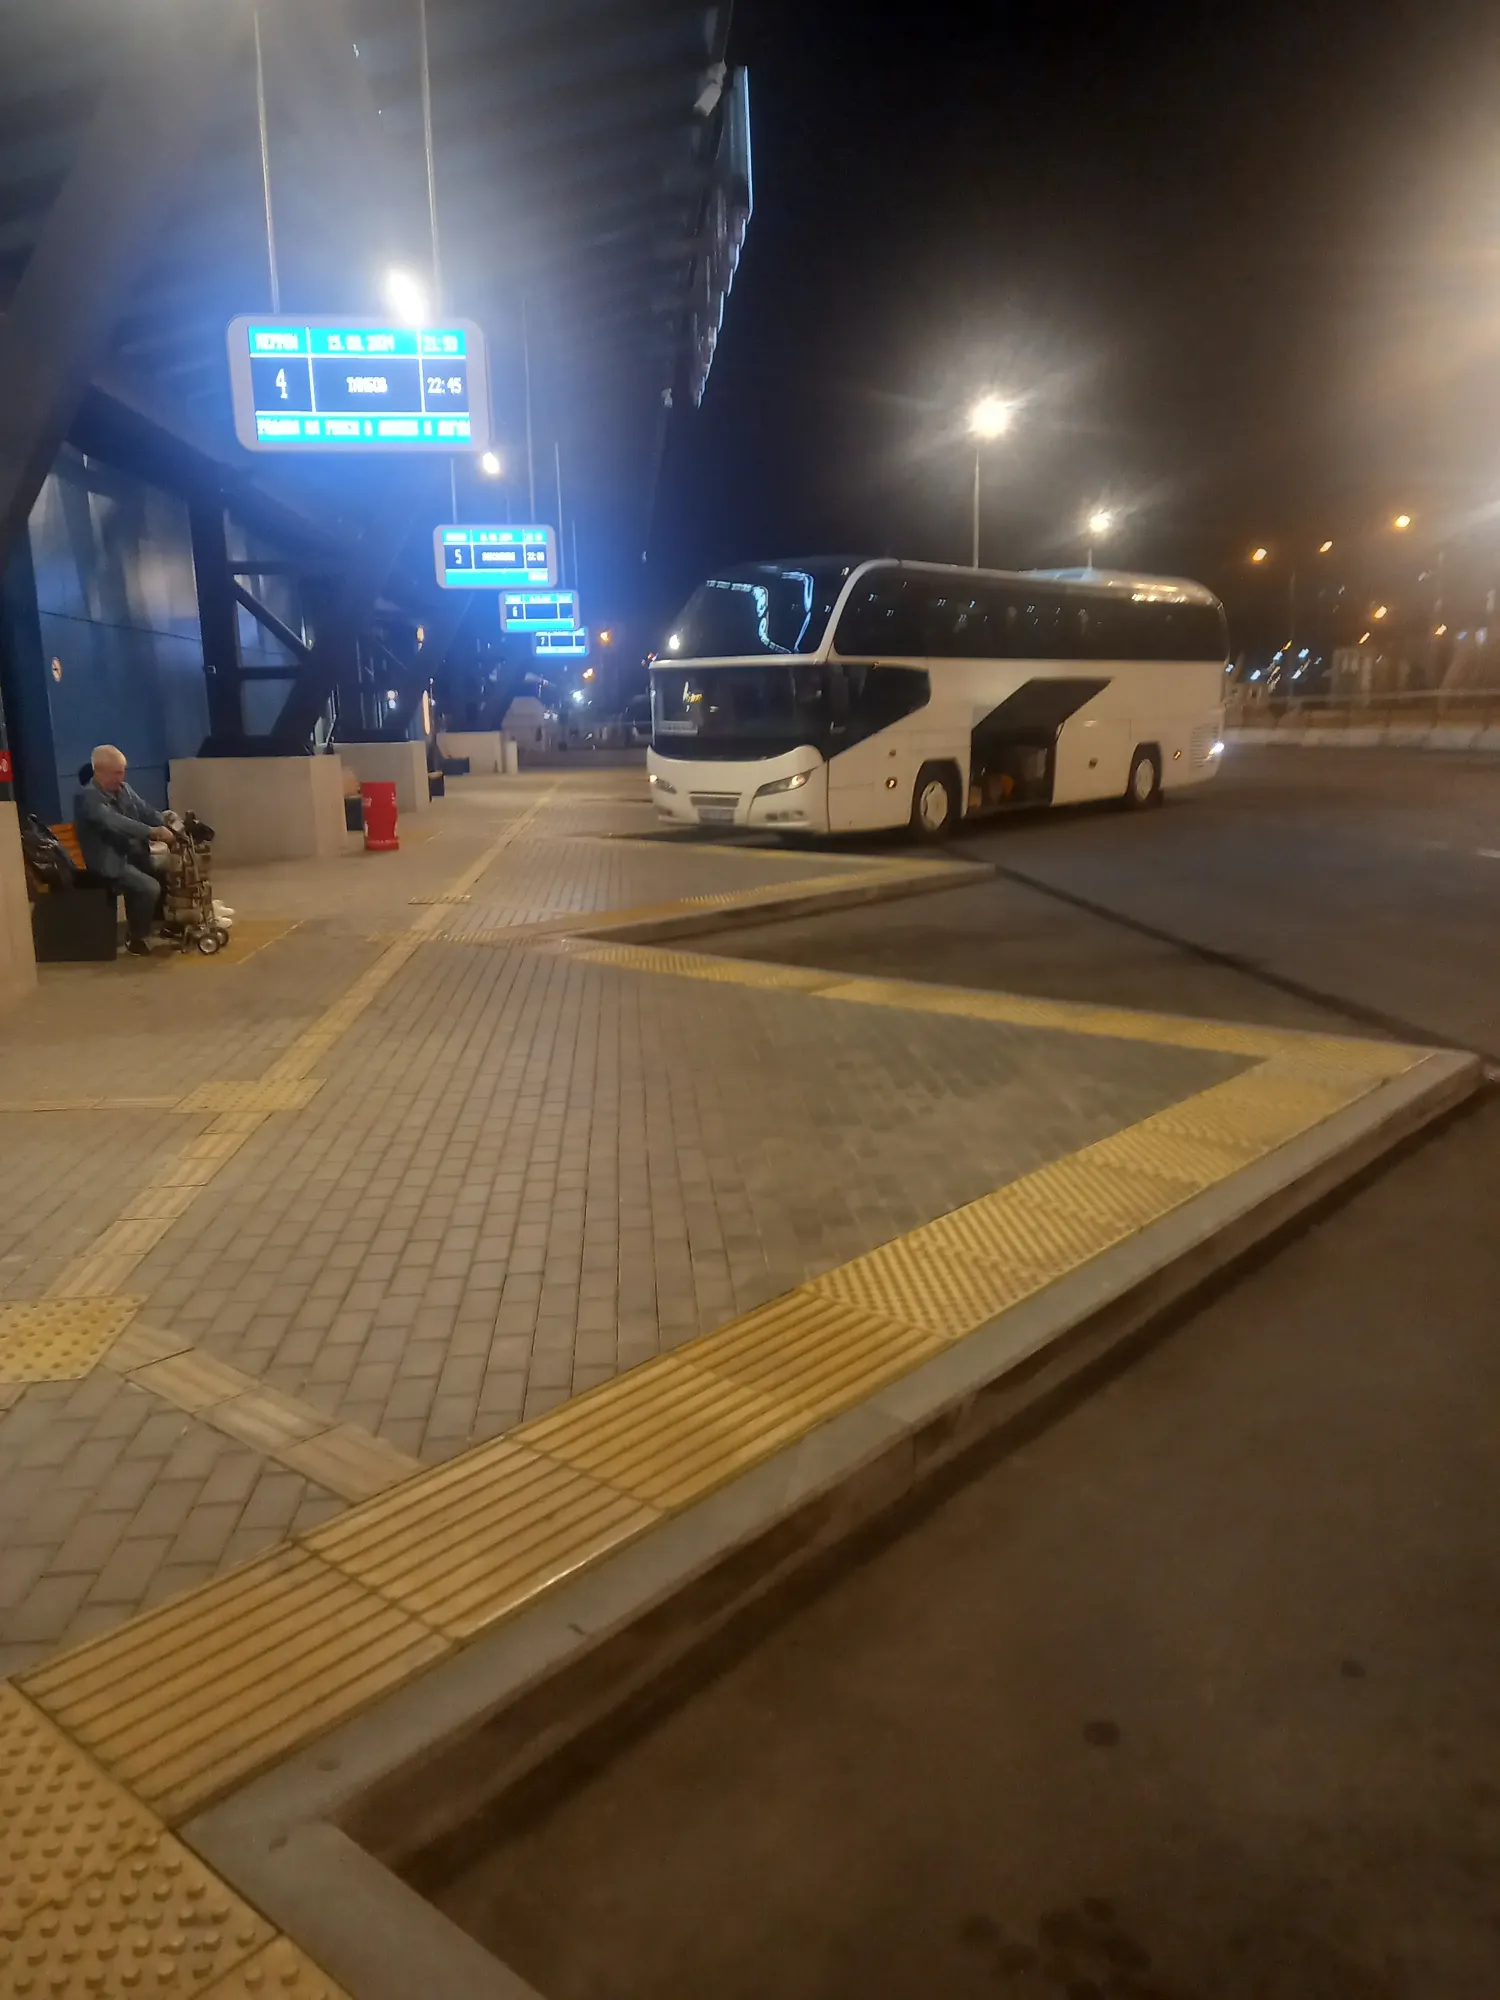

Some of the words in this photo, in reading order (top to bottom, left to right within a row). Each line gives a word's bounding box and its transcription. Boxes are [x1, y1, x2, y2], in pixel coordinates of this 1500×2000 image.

[275, 368, 288, 399] 4
[427, 377, 462, 394] 22:45
[454, 548, 462, 564] 5
